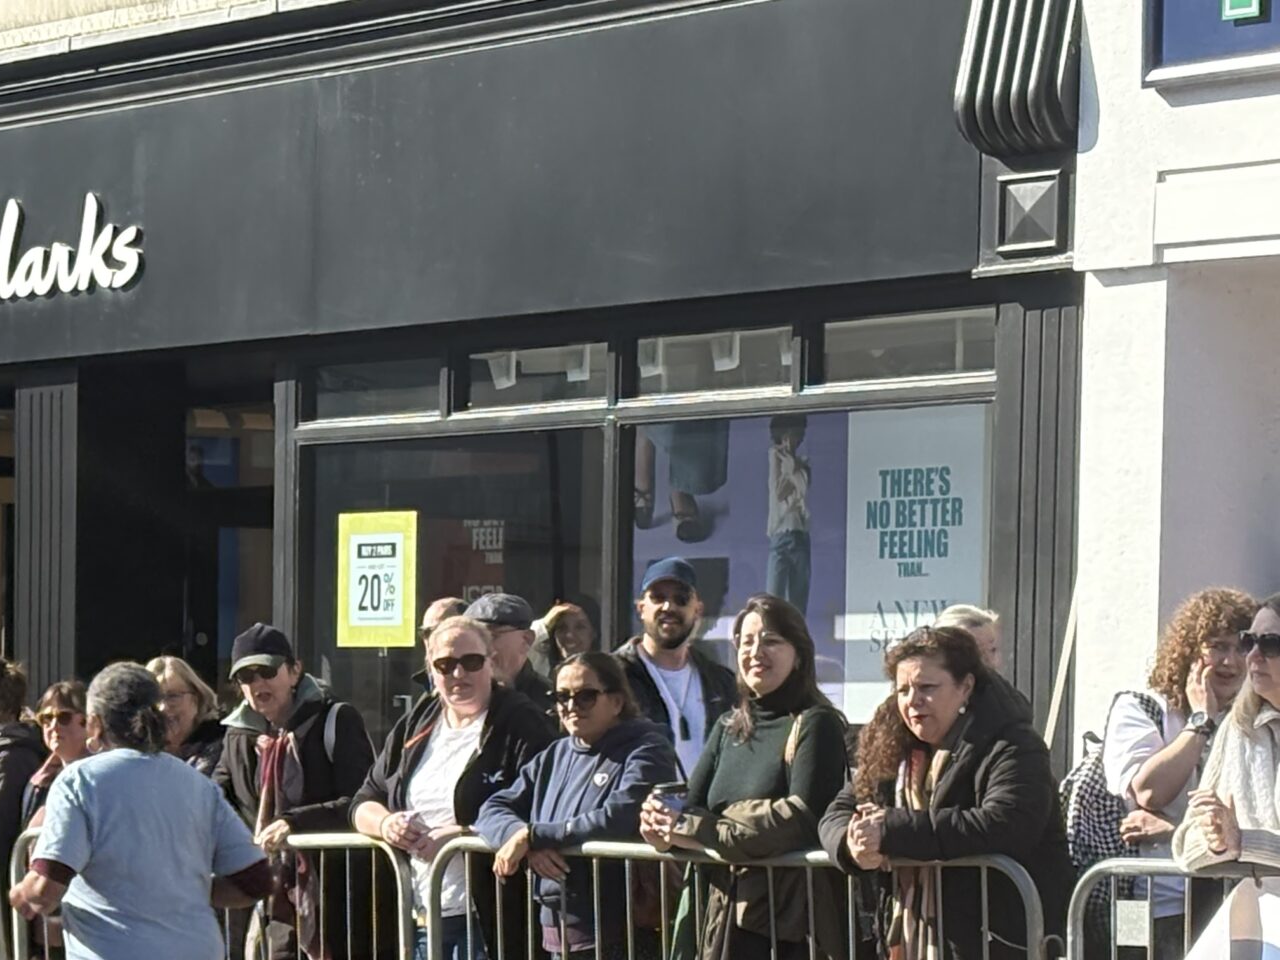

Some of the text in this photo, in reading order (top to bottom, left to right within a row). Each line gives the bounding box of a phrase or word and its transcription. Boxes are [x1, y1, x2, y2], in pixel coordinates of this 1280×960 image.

[879, 466, 951, 498] THERE'S
[866, 497, 963, 530] NO BETTER
[879, 528, 948, 559] FEELING
[358, 574, 381, 612] 20
